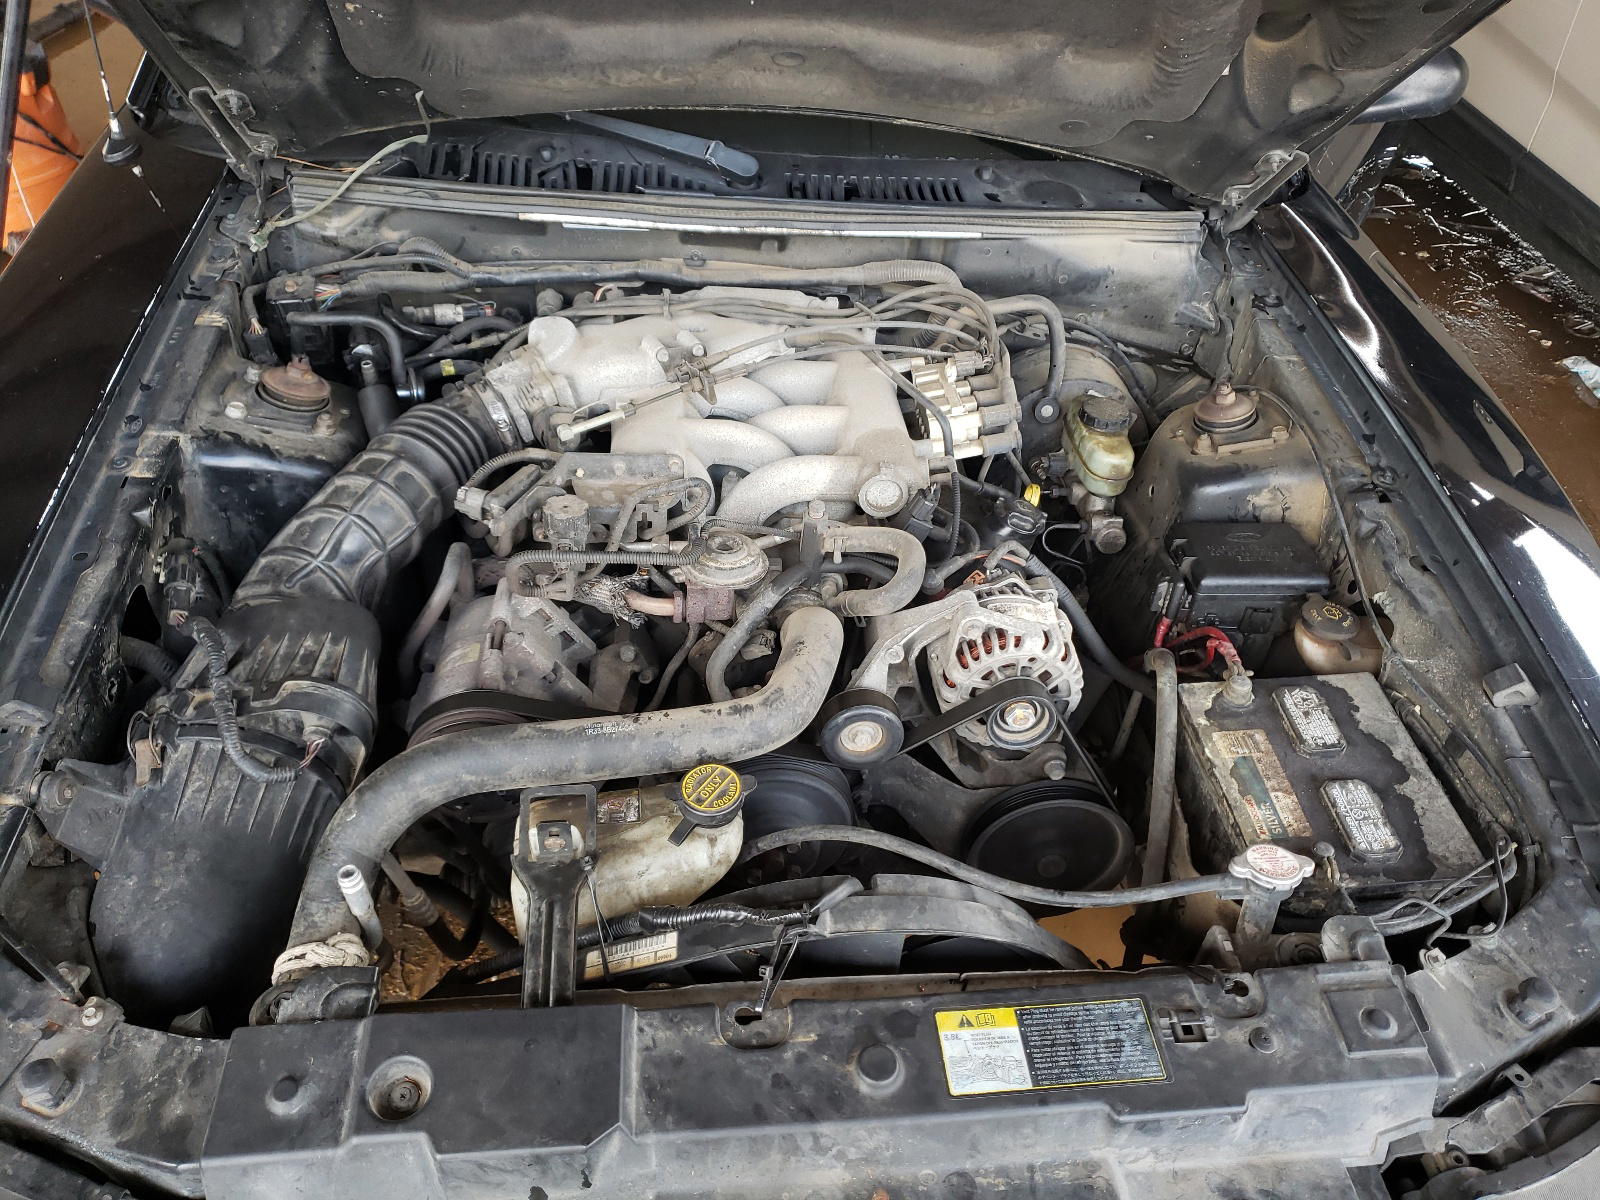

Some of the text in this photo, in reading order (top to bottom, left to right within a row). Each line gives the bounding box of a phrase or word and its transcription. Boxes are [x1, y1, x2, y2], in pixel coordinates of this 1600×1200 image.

[686, 766, 713, 793] RADIATOR
[700, 776, 722, 798] ONLY
[713, 782, 737, 808] COOLANT
[1332, 787, 1348, 811] POISON
[1260, 801, 1283, 834] SILVER
